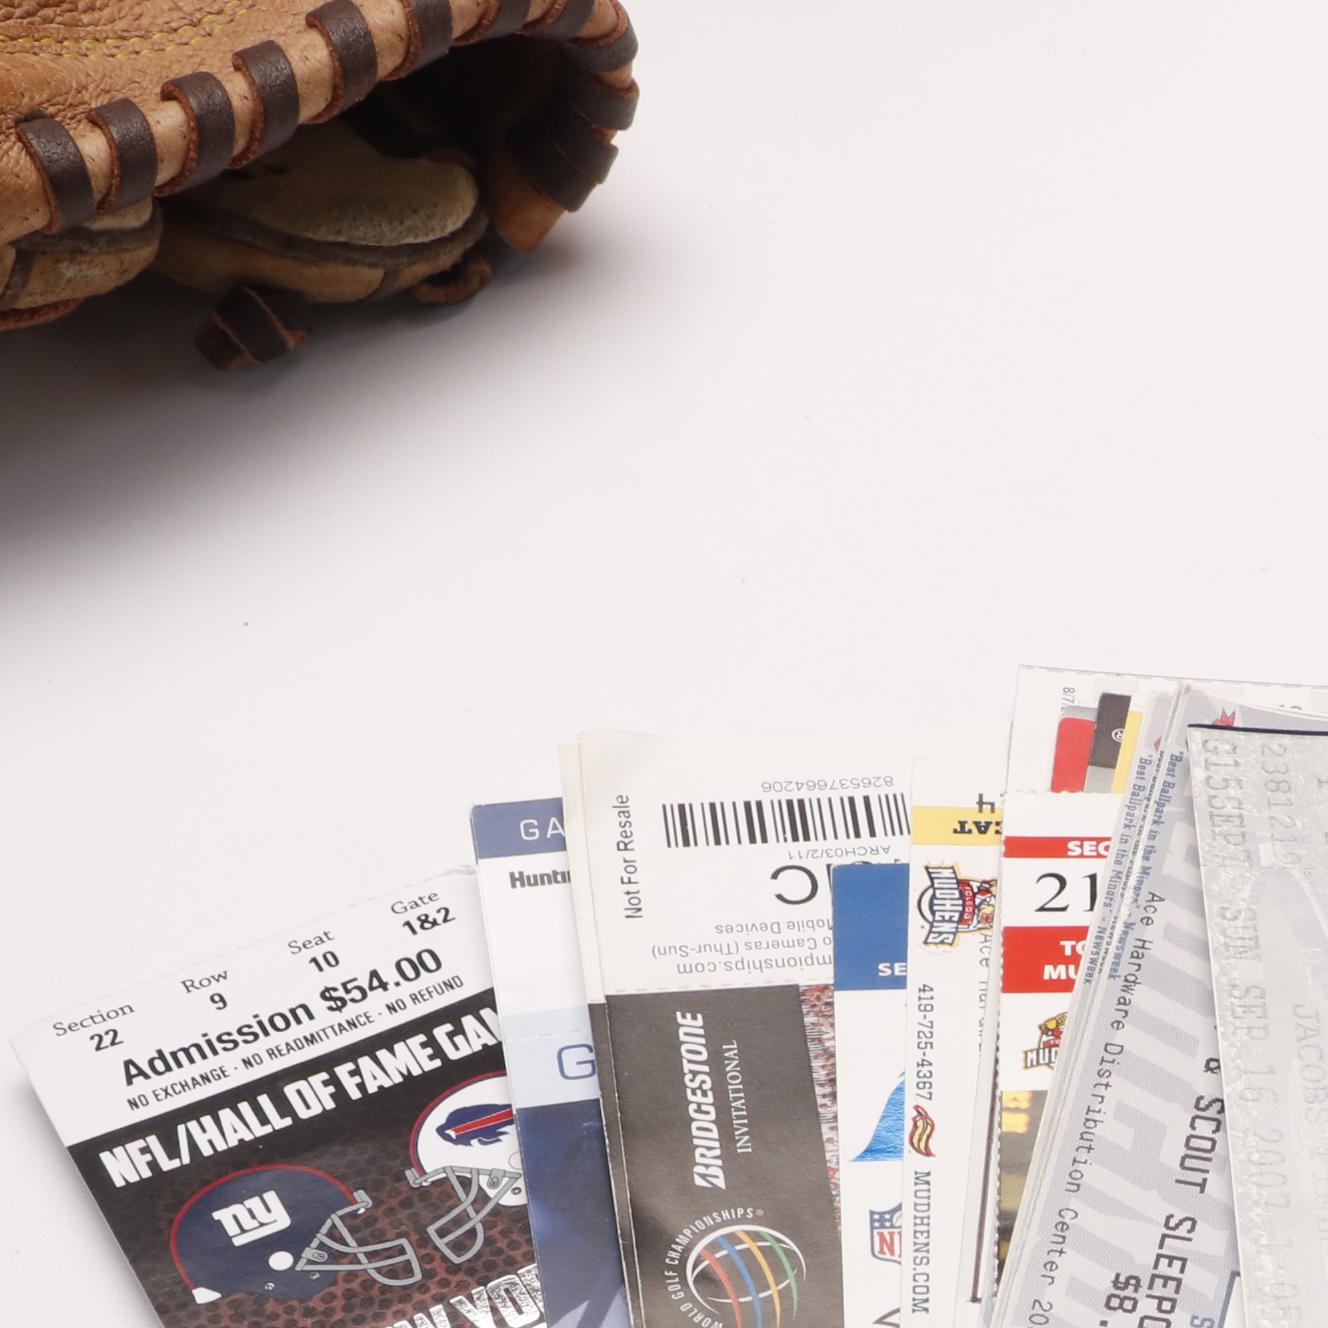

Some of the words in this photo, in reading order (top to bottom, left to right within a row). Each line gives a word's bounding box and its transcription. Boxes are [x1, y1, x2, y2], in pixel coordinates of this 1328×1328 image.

[616, 794, 639, 852] Resale
[760, 776, 894, 793] 826537664206
[620, 855, 640, 885] For
[787, 844, 892, 860] ARCH03/2/11
[623, 889, 644, 920] Not
[715, 923, 782, 936] Devices
[746, 934, 818, 952] Cameras
[923, 865, 962, 945] MUDHENS
[1140, 891, 1166, 926] Ace
[52, 1000, 136, 1039] Section
[180, 967, 230, 996] Row
[287, 928, 335, 957] Seat
[389, 888, 441, 918] Gate
[89, 1027, 125, 1055] 22
[208, 991, 229, 1013] 9
[307, 949, 341, 974] 10
[400, 905, 457, 939] 1&2
[651, 942, 742, 960] (Thur-Sun)
[1111, 938, 1154, 1031] Hardware
[121, 1000, 316, 1088] Admission
[318, 946, 444, 1017] $54.00
[126, 1095, 150, 1113] NO
[152, 1064, 232, 1106] EXCHANGE
[241, 1049, 265, 1071] NO
[265, 1010, 376, 1062] READMITTANCE
[385, 999, 409, 1017] NO
[409, 973, 465, 1007] REFUND
[915, 982, 935, 1102] 419-725-4367
[99, 1080, 294, 1190] NFL/HALL
[296, 1069, 339, 1120] OF
[334, 1032, 442, 1102] FAME
[677, 1010, 727, 1191] BRIDGESTONE
[722, 1039, 752, 1154] INVITATIONAL
[1065, 1042, 1124, 1194] Distribution
[1175, 1095, 1225, 1194] SCOUT
[665, 1207, 755, 1266] CHAMPIONSHIPS
[911, 1169, 931, 1315] MUDHENS.COM
[1040, 1207, 1079, 1286] Center
[664, 1271, 685, 1301] GOLF
